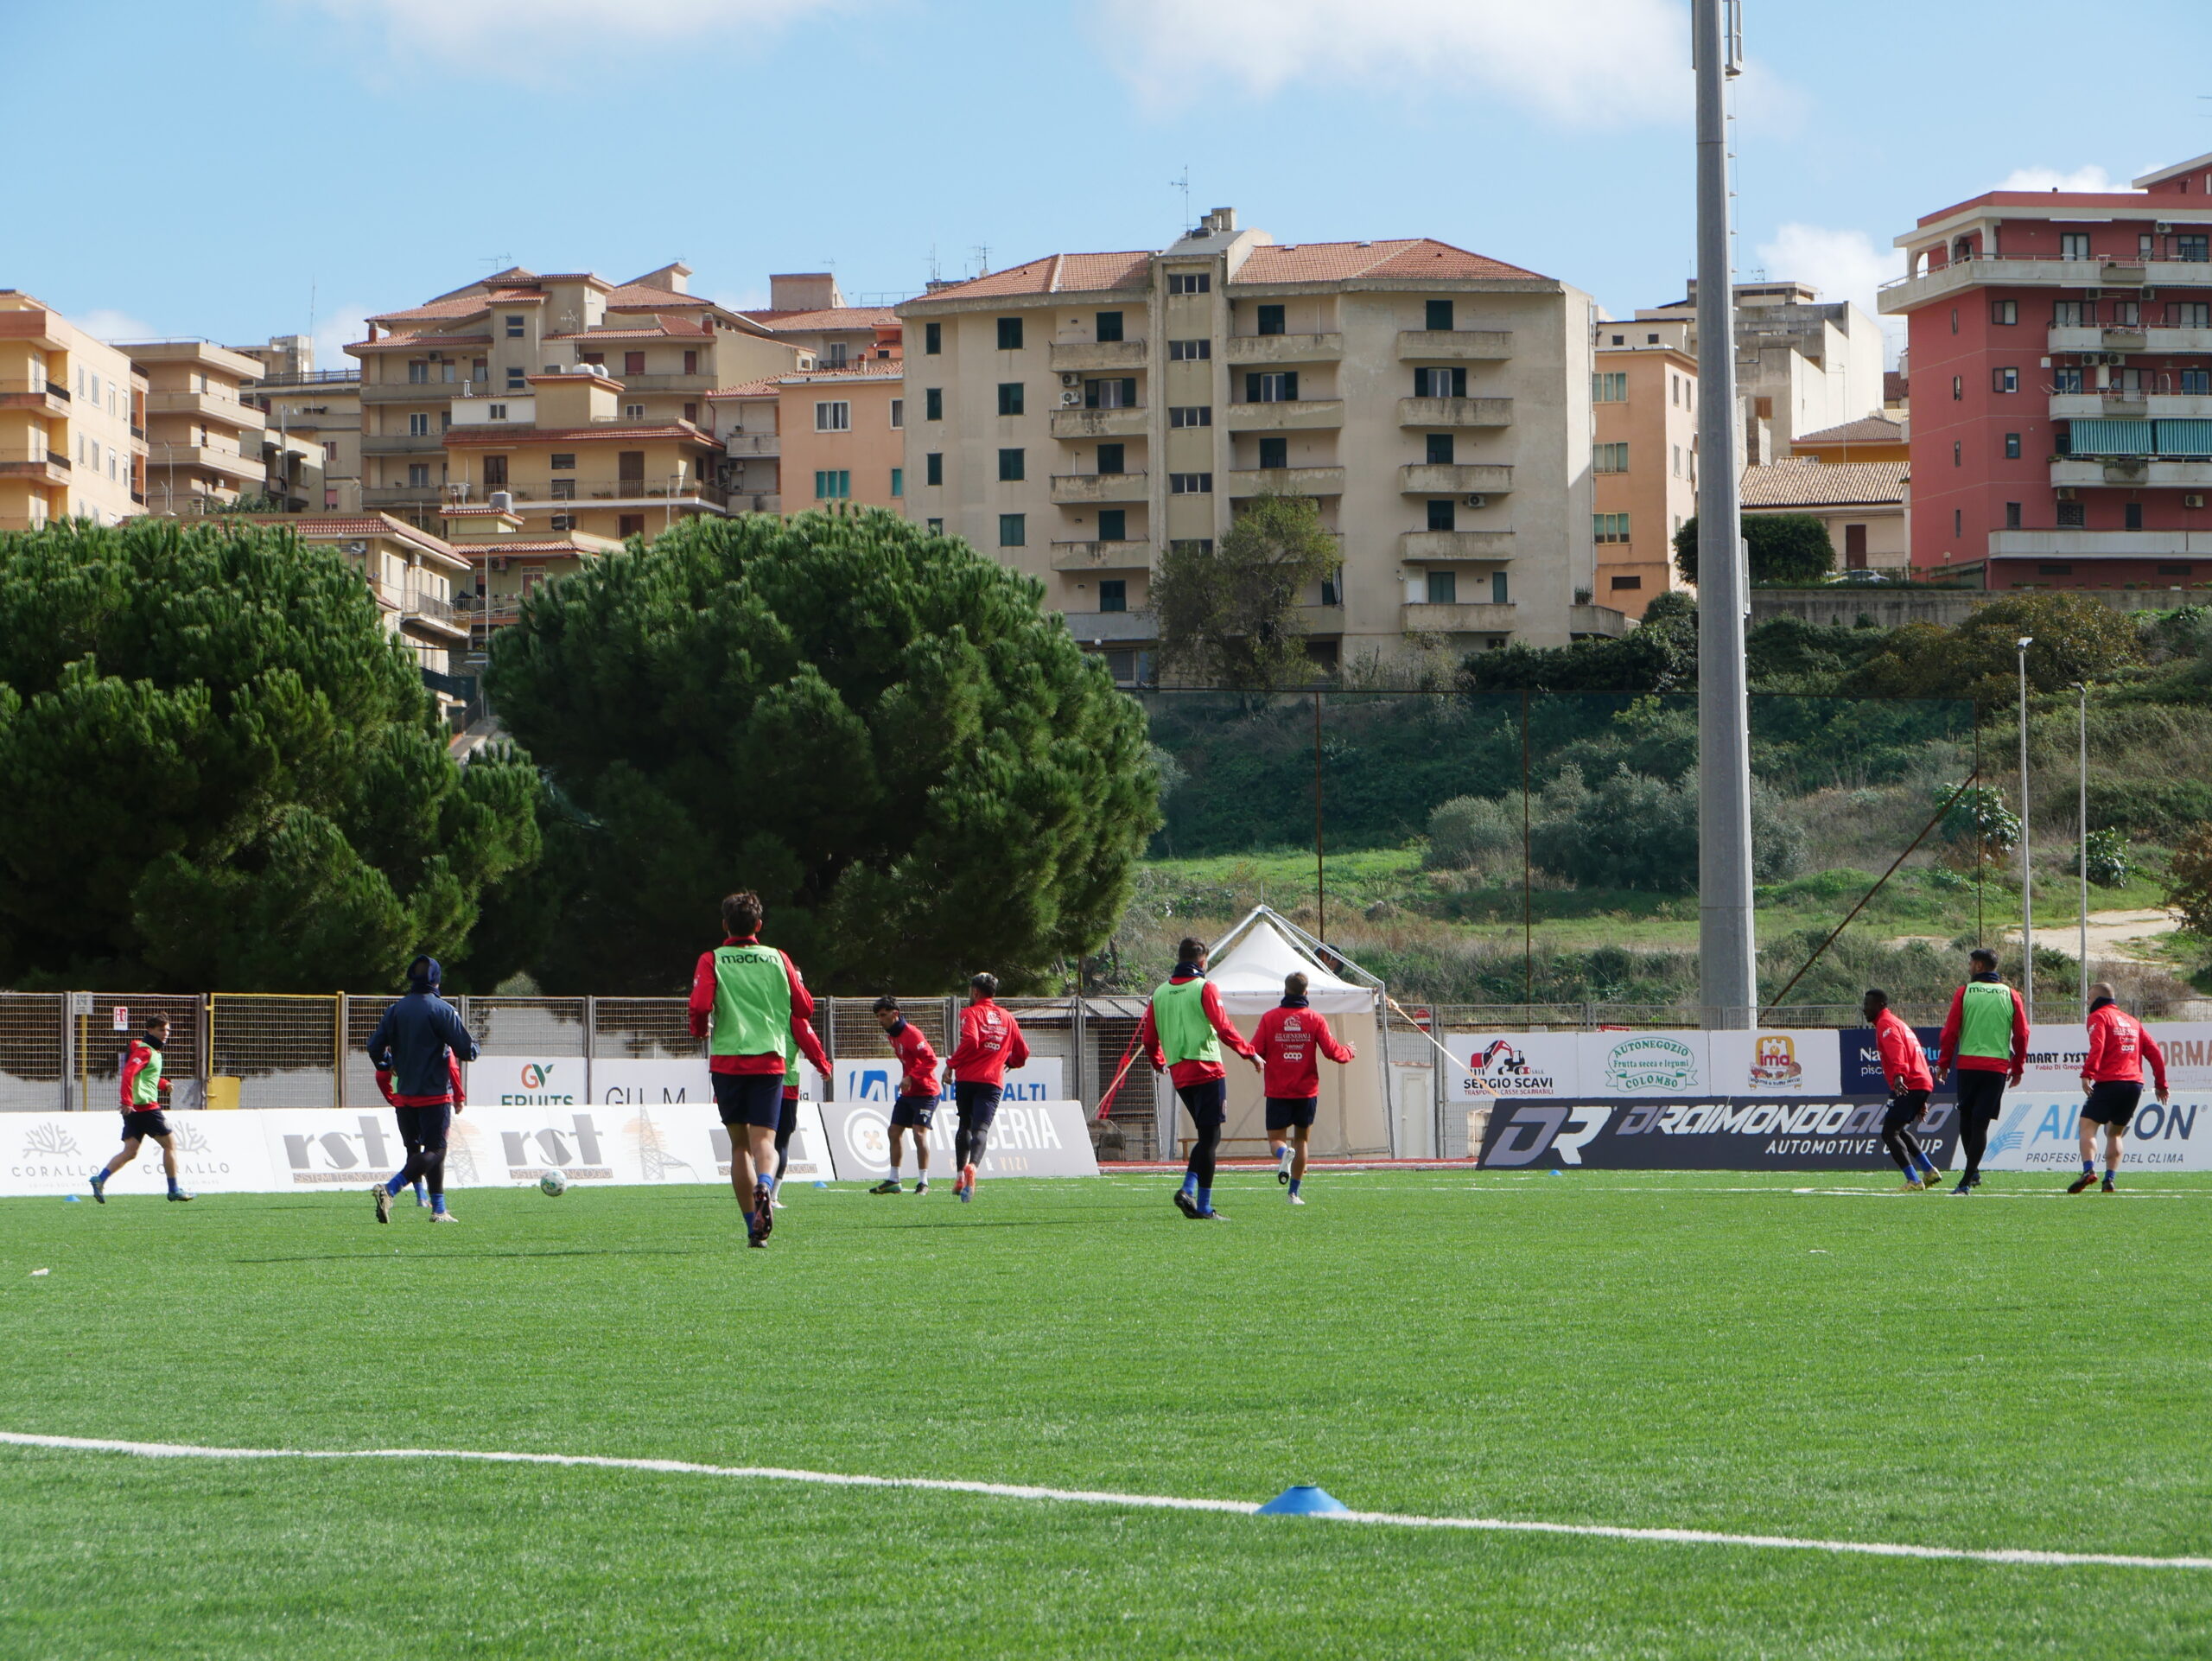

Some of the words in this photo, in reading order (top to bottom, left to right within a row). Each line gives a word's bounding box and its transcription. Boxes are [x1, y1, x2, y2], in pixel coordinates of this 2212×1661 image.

[721, 954, 778, 964] macron
[1969, 987, 2009, 996] macron
[1613, 1040, 1689, 1059] AUTONEGOZIO
[1283, 1053, 1303, 1061] coop
[1759, 1050, 1790, 1066] ima
[2025, 1053, 2059, 1064] MART
[2063, 1052, 2088, 1063] SYST
[1613, 1060, 1637, 1068] Frutta
[1664, 1060, 1689, 1069] legumi
[1515, 1077, 1553, 1089] SCAVI
[1625, 1074, 1678, 1089] COLOMBO
[501, 1113, 603, 1167] rst
[1484, 1105, 1612, 1166] DR
[283, 1116, 391, 1169] rst
[1764, 1138, 1878, 1155] AUTOMOTIVE
[2122, 1153, 2144, 1163] DEL
[2147, 1153, 2184, 1163] CLIMA
[11, 1164, 100, 1177] CORALLO
[143, 1162, 230, 1174] COALLO
